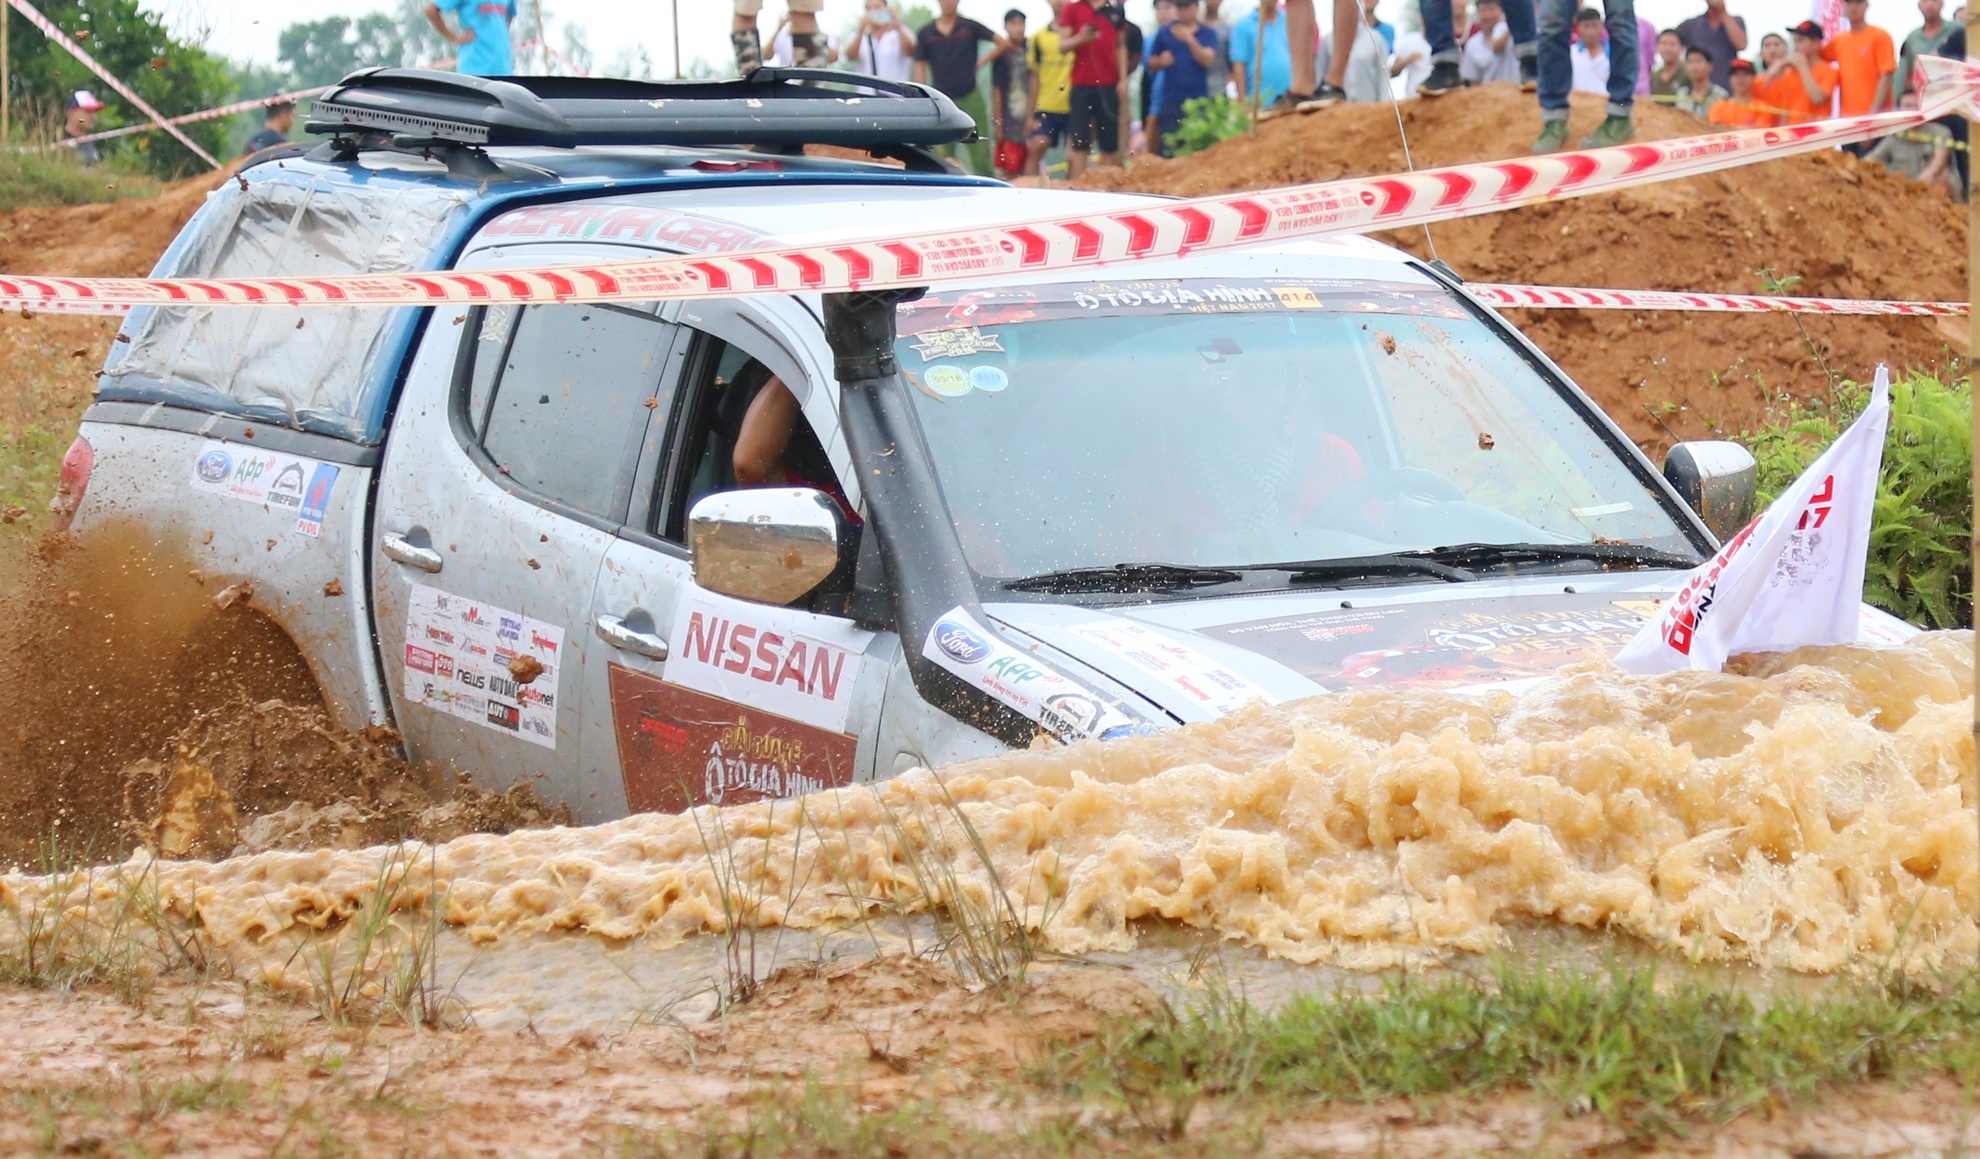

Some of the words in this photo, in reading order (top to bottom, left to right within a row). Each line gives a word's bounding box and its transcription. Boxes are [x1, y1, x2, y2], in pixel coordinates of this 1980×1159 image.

[1280, 292, 1317, 302] 414
[682, 611, 846, 701] NISSAN
[940, 629, 983, 658] Ford
[704, 741, 726, 805] Ô
